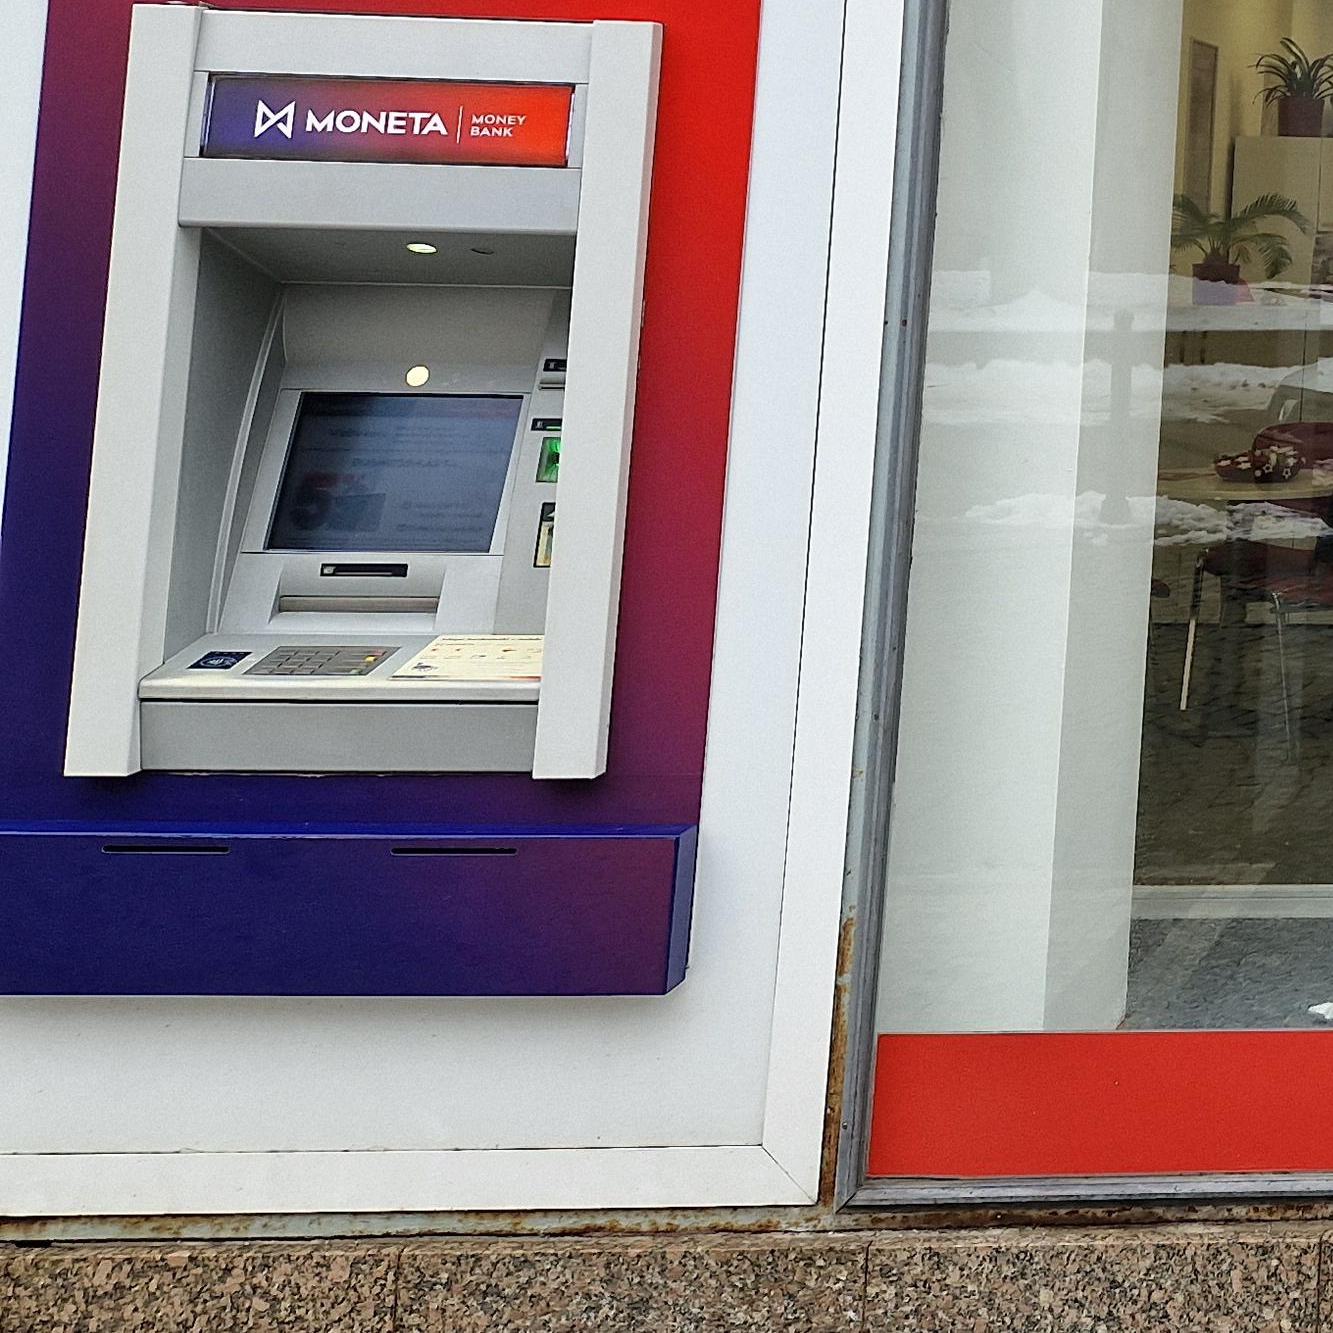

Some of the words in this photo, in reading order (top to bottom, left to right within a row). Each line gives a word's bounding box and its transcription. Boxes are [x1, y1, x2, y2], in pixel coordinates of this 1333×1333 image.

[305, 109, 448, 135] MONETA
[471, 114, 527, 126] MONEY
[470, 126, 513, 137] BANK
